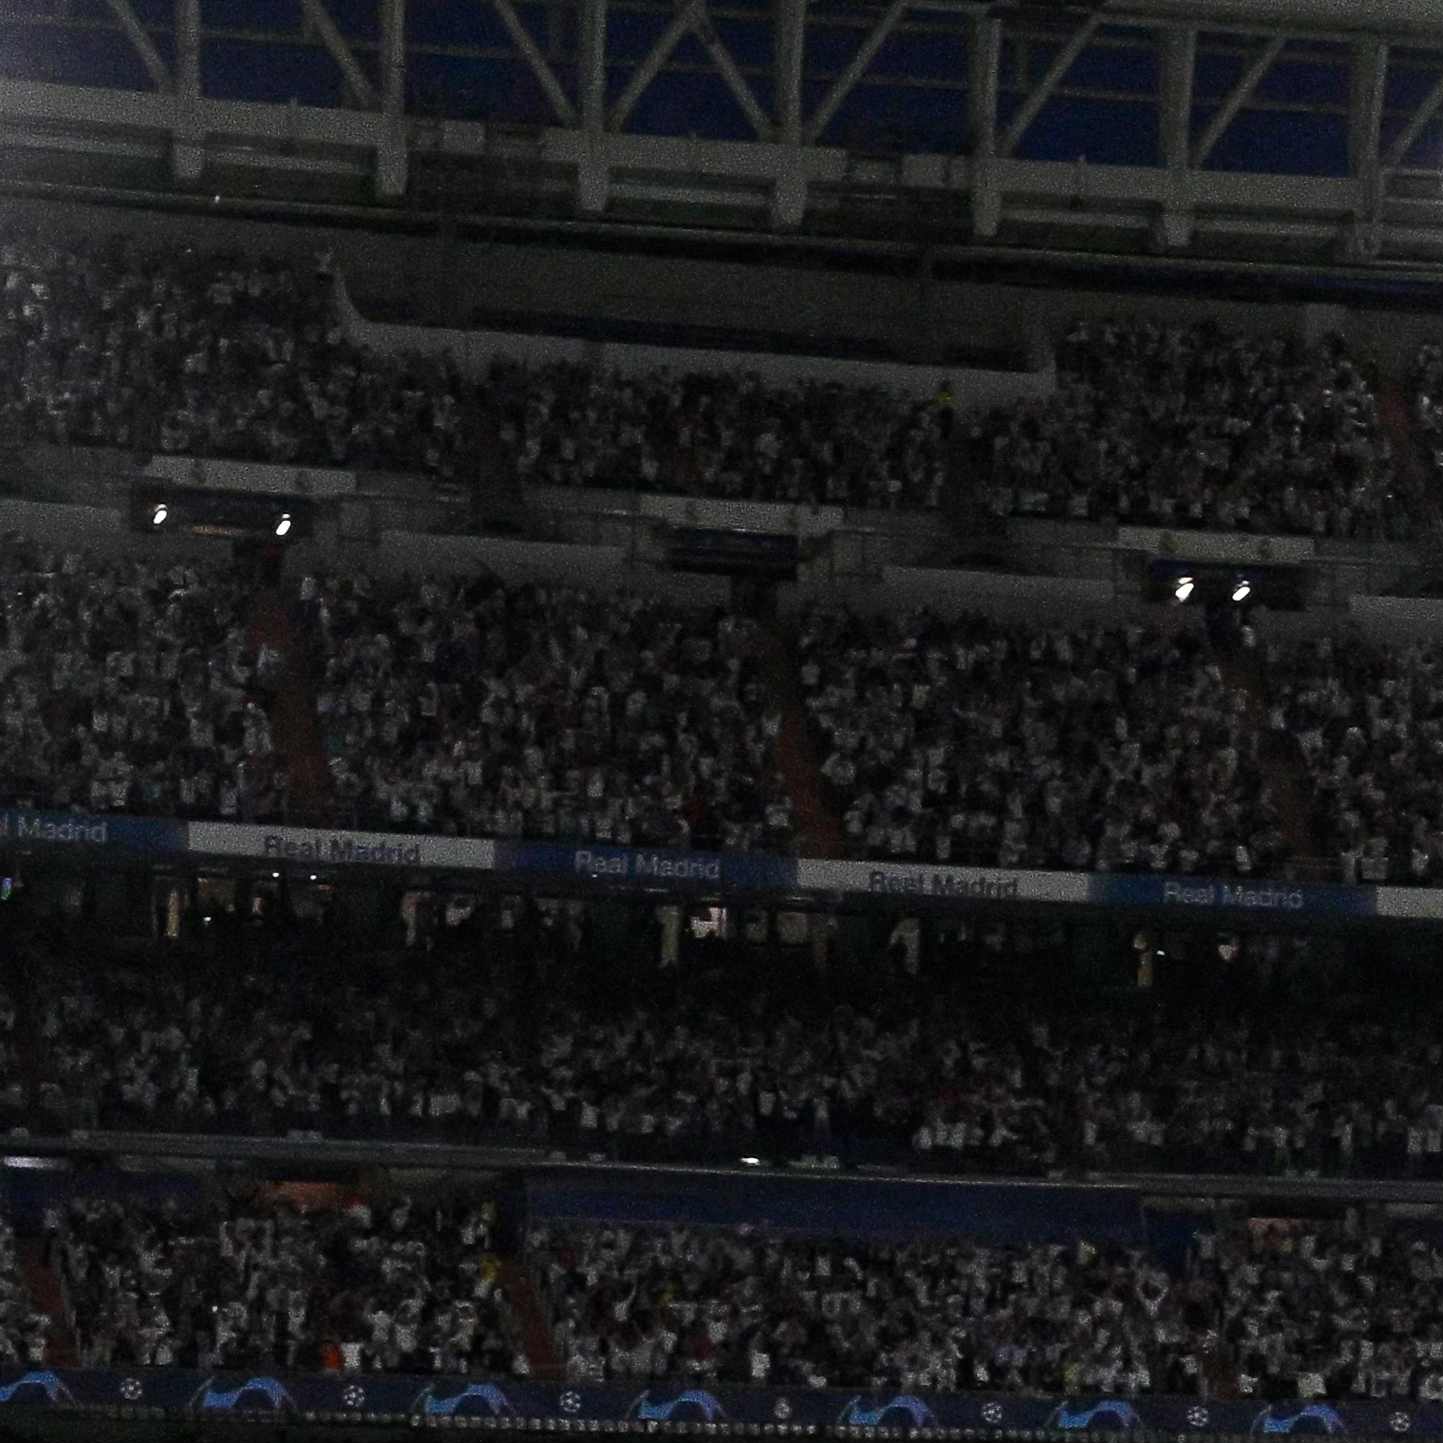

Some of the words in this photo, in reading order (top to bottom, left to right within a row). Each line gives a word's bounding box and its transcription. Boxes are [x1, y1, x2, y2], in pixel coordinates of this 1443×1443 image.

[17, 815, 109, 844] Madrid
[265, 835, 322, 862] Real
[329, 838, 421, 866] Madrid
[575, 850, 628, 875] Real
[635, 853, 721, 880] Madrid
[1164, 881, 1215, 906] Real
[1220, 884, 1304, 910] Madrid
